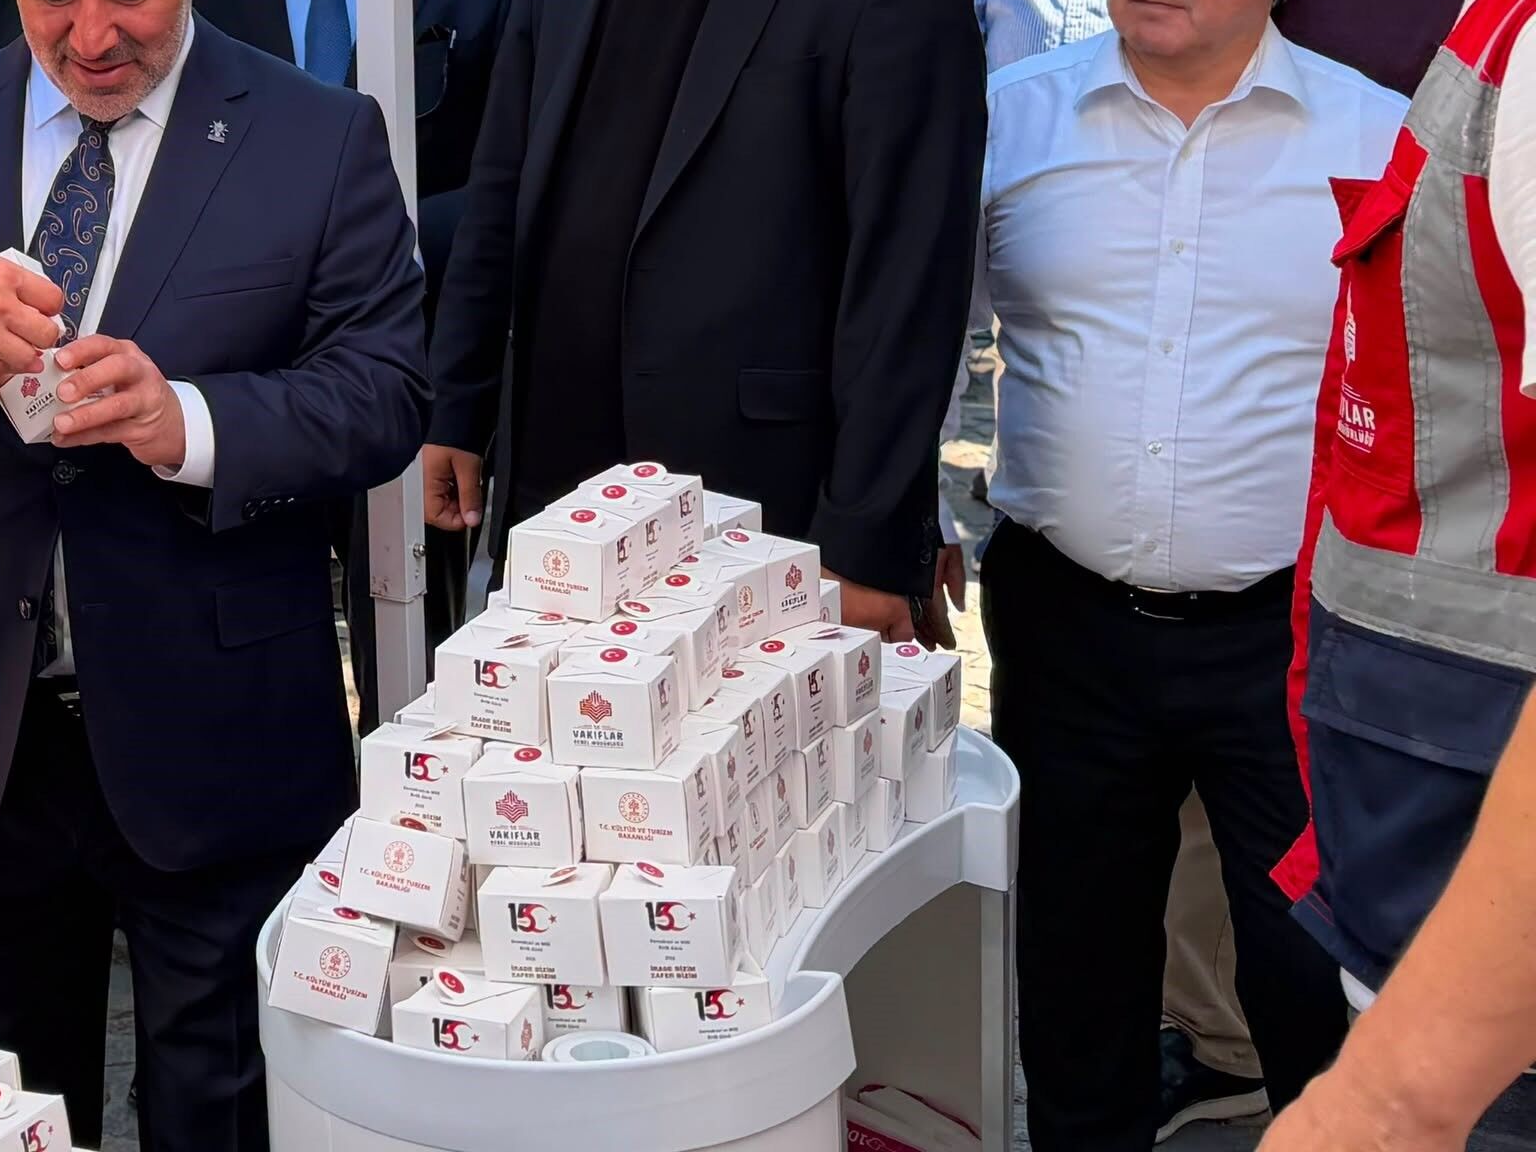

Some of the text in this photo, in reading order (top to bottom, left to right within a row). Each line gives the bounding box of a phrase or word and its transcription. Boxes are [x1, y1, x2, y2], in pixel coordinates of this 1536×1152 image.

[572, 729, 624, 741] VAKIFLAR
[404, 751, 438, 782] 15
[488, 829, 541, 841] VAKIFLAR
[508, 902, 545, 933] 15
[645, 901, 683, 932] 15
[695, 988, 732, 1022] 15
[432, 1018, 467, 1051] 15
